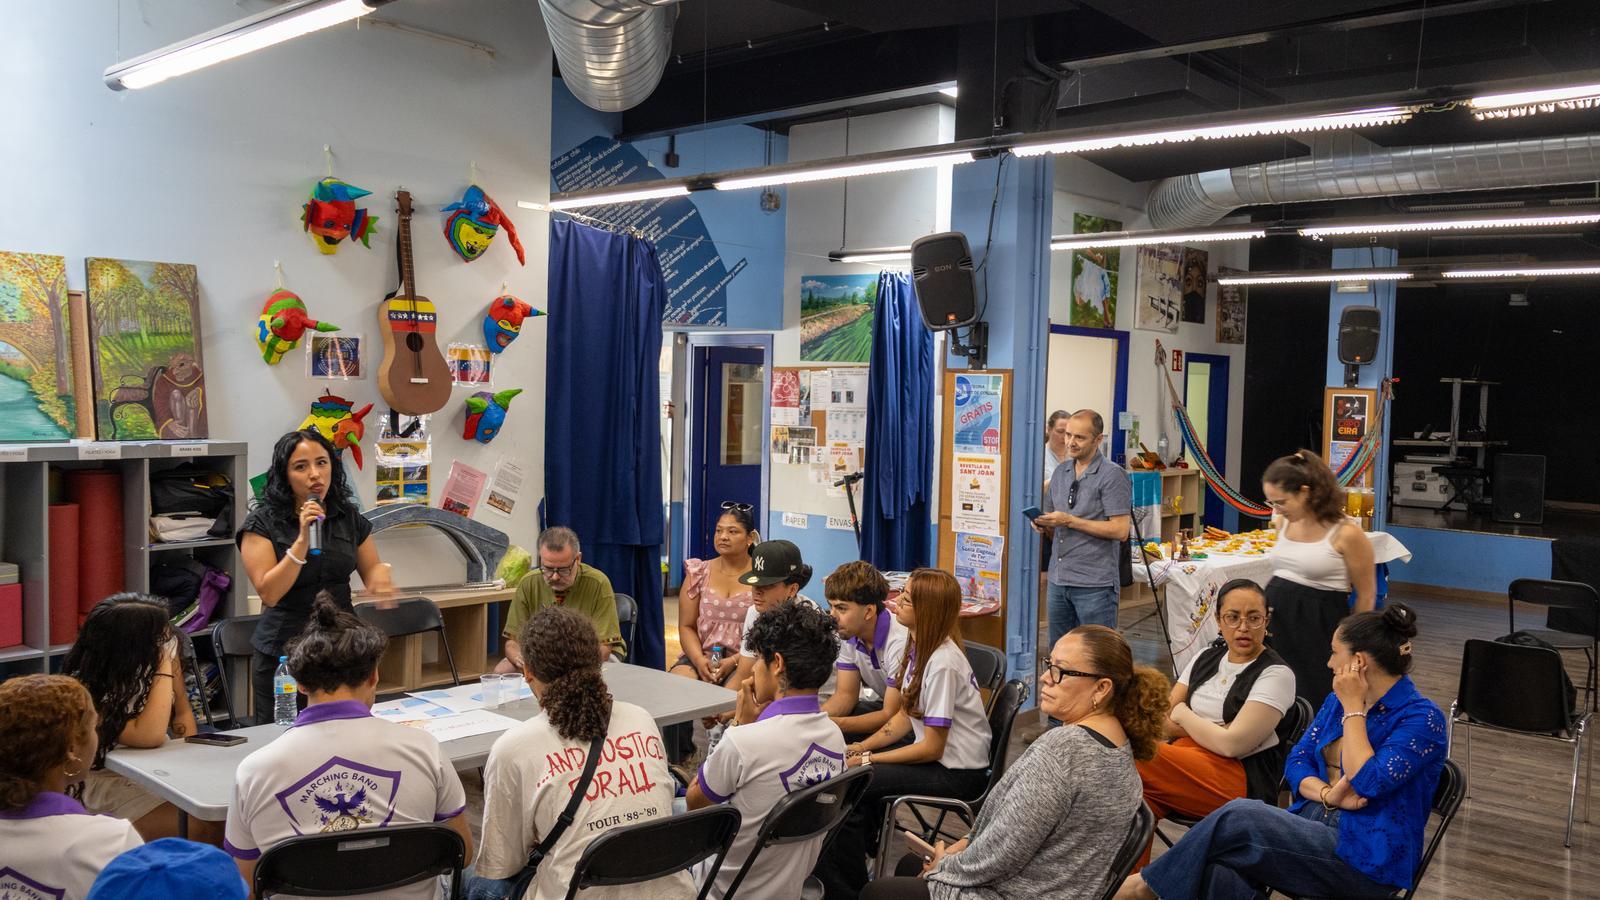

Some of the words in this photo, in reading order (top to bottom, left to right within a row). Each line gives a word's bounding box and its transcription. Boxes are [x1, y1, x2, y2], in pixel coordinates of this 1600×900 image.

[960, 401, 993, 424] GRATIS
[785, 515, 806, 527] PAPER
[829, 517, 862, 529] ENVASS
[598, 731, 664, 766] USTIC
[618, 762, 656, 796] ALL
[798, 756, 822, 784] MARCHING
[822, 757, 836, 771] BAND
[300, 772, 349, 804] MARCHING
[352, 773, 378, 791] BAND
[587, 815, 621, 832] TOUR
[20, 885, 42, 900] BAN
